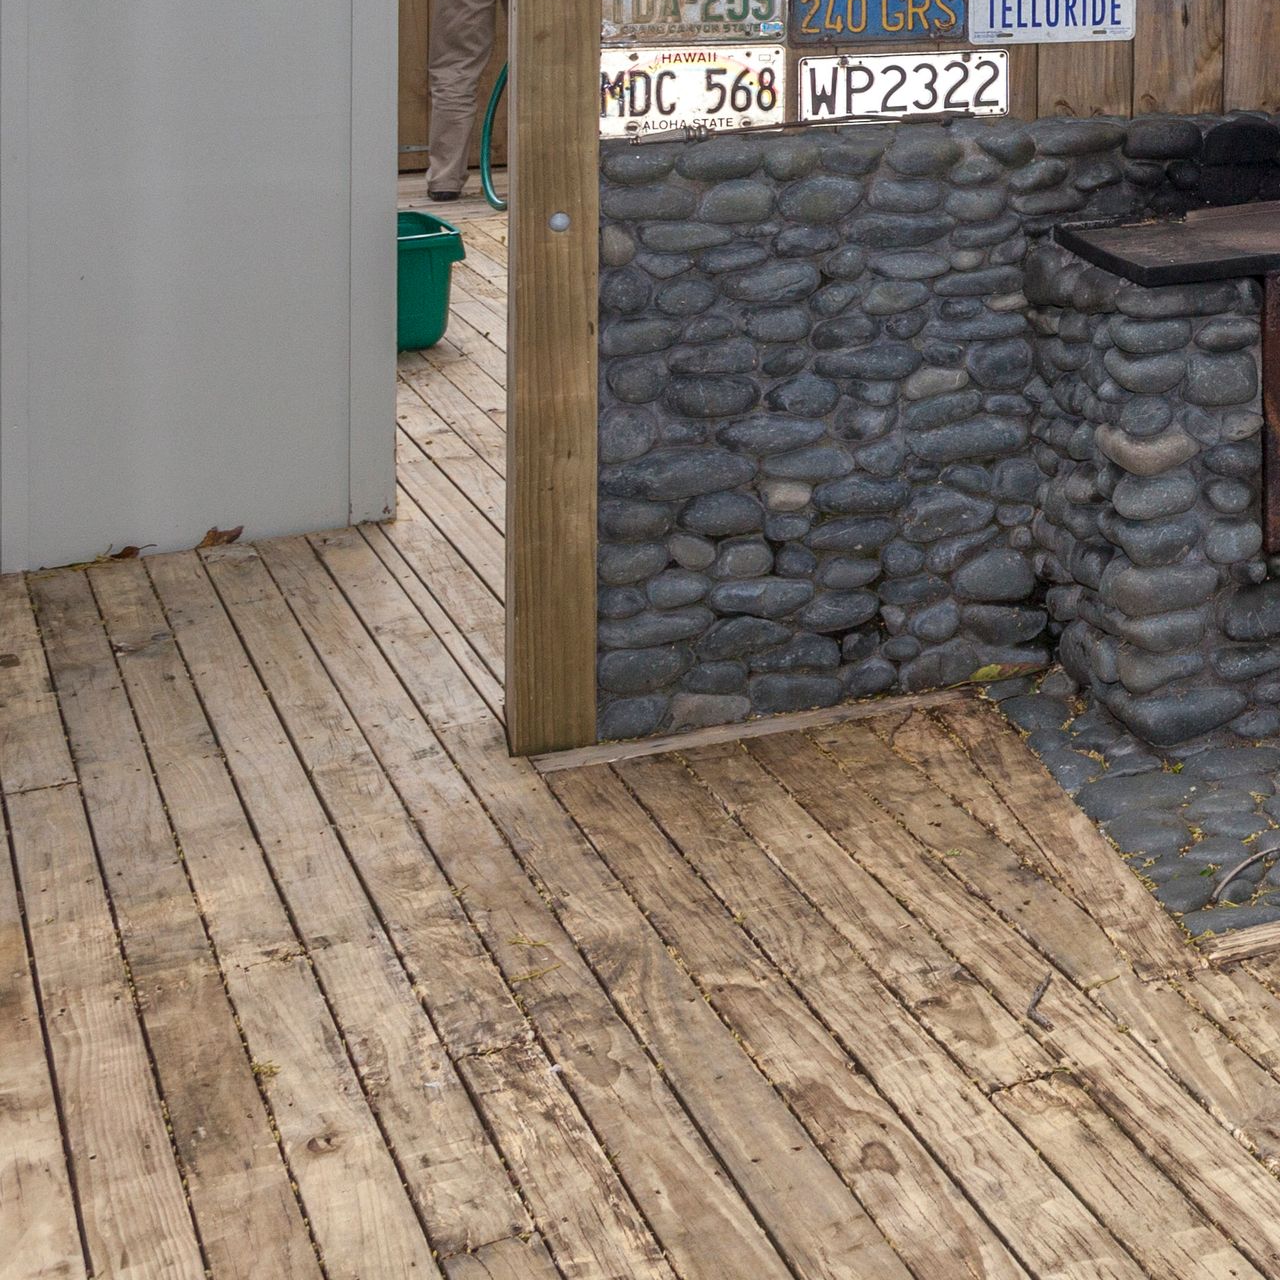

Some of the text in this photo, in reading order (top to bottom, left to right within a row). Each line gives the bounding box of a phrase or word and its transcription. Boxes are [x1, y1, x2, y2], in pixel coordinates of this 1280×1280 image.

[622, 24, 665, 34] GRAND
[668, 23, 720, 33] CANYON
[723, 23, 761, 32] STATE
[662, 52, 717, 63] HAWAII
[600, 67, 777, 118] MDC 568
[642, 118, 734, 130] ALOHA STATE
